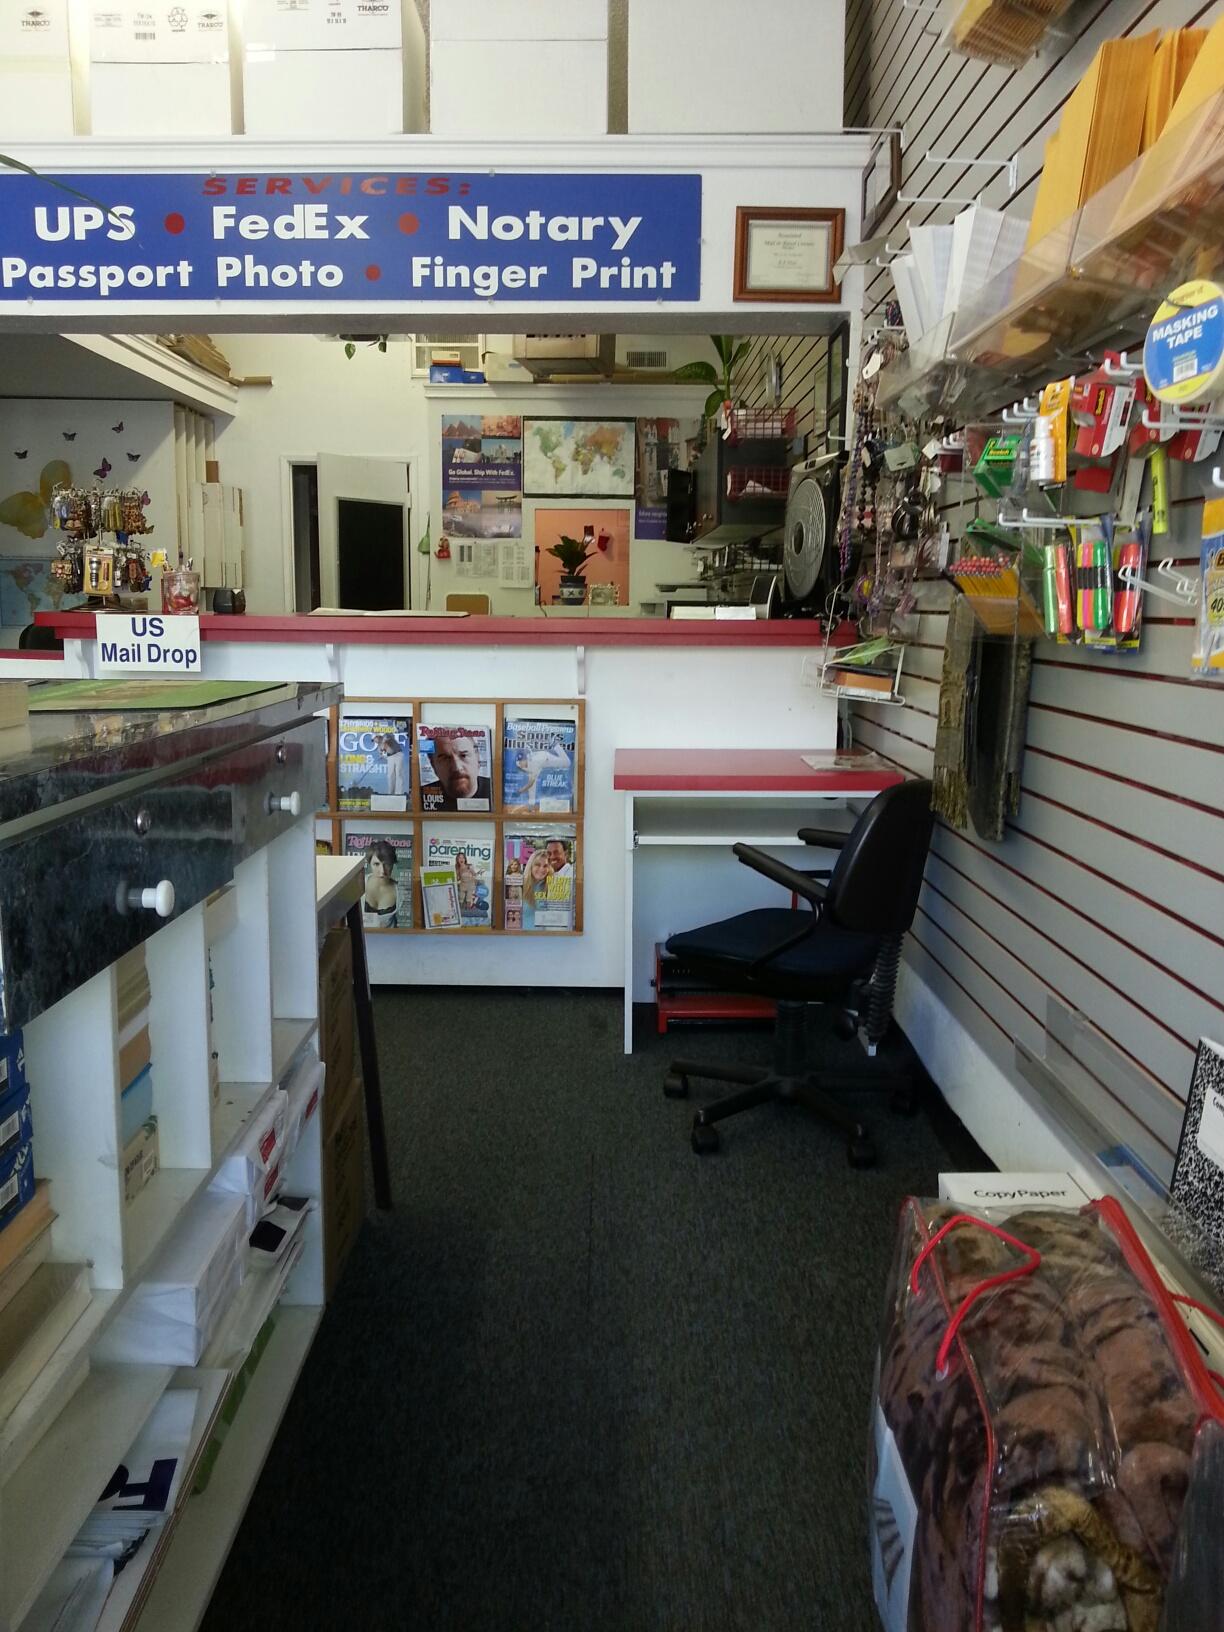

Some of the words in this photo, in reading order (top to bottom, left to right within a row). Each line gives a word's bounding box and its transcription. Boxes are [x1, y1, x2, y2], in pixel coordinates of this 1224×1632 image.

[202, 177, 471, 195] SERVICES:
[34, 206, 136, 241] UPS
[212, 204, 371, 240] FedEx
[448, 206, 643, 250] Notary
[2, 257, 193, 296] Passport
[216, 255, 344, 287] Photo
[411, 256, 548, 296] Finger
[572, 257, 676, 288] Print
[1152, 304, 1219, 343] MASKING
[1166, 325, 1203, 350] TAPE
[131, 617, 164, 637] US
[101, 643, 141, 662] Mail
[147, 643, 197, 668] Drop
[517, 731, 564, 741] Sports
[423, 795, 444, 803] LOUIS
[424, 803, 438, 811] C.K.
[429, 844, 491, 860] parenting
